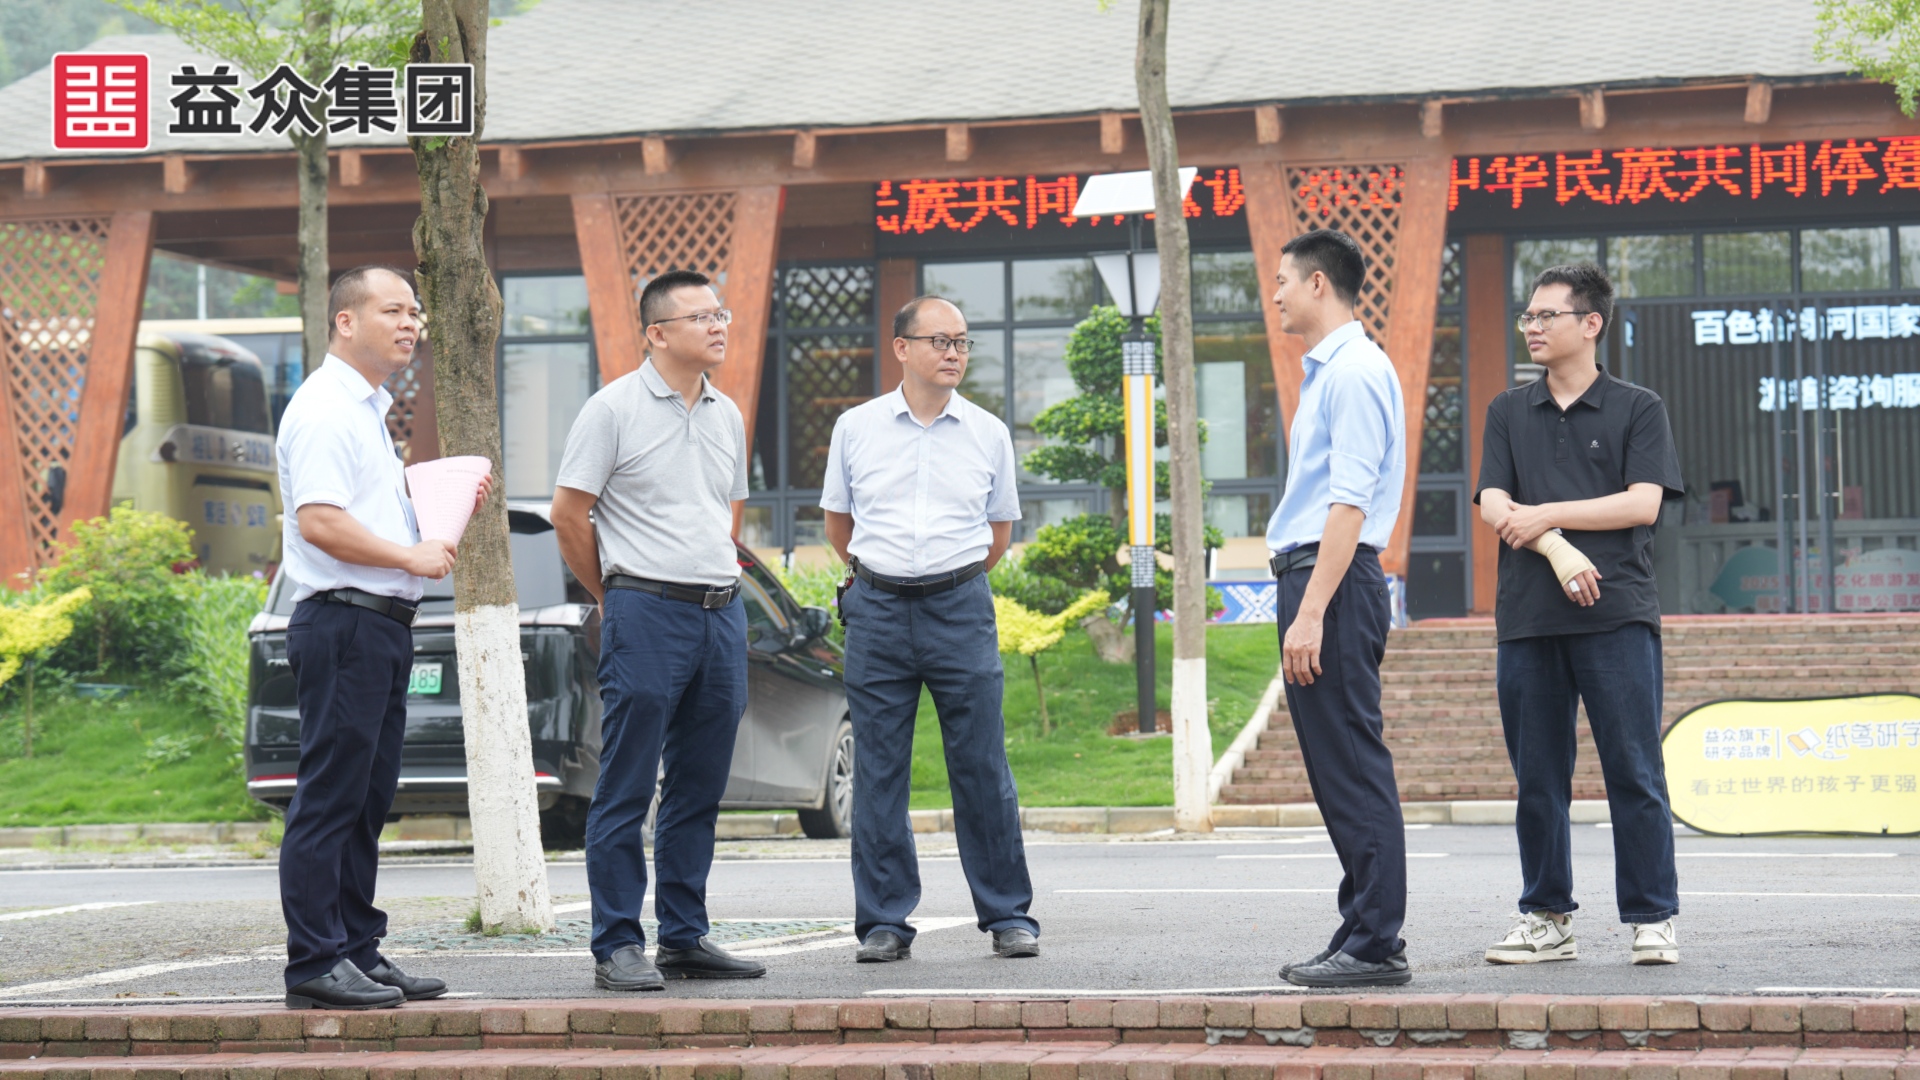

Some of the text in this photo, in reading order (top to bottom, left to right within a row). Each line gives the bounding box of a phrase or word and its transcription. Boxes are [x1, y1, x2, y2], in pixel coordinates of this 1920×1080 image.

[1705, 728, 1771, 742] 益众旗下
[1705, 746, 1771, 759] 研学品牌
[1691, 774, 1916, 796] 看过世界的孩子更强
